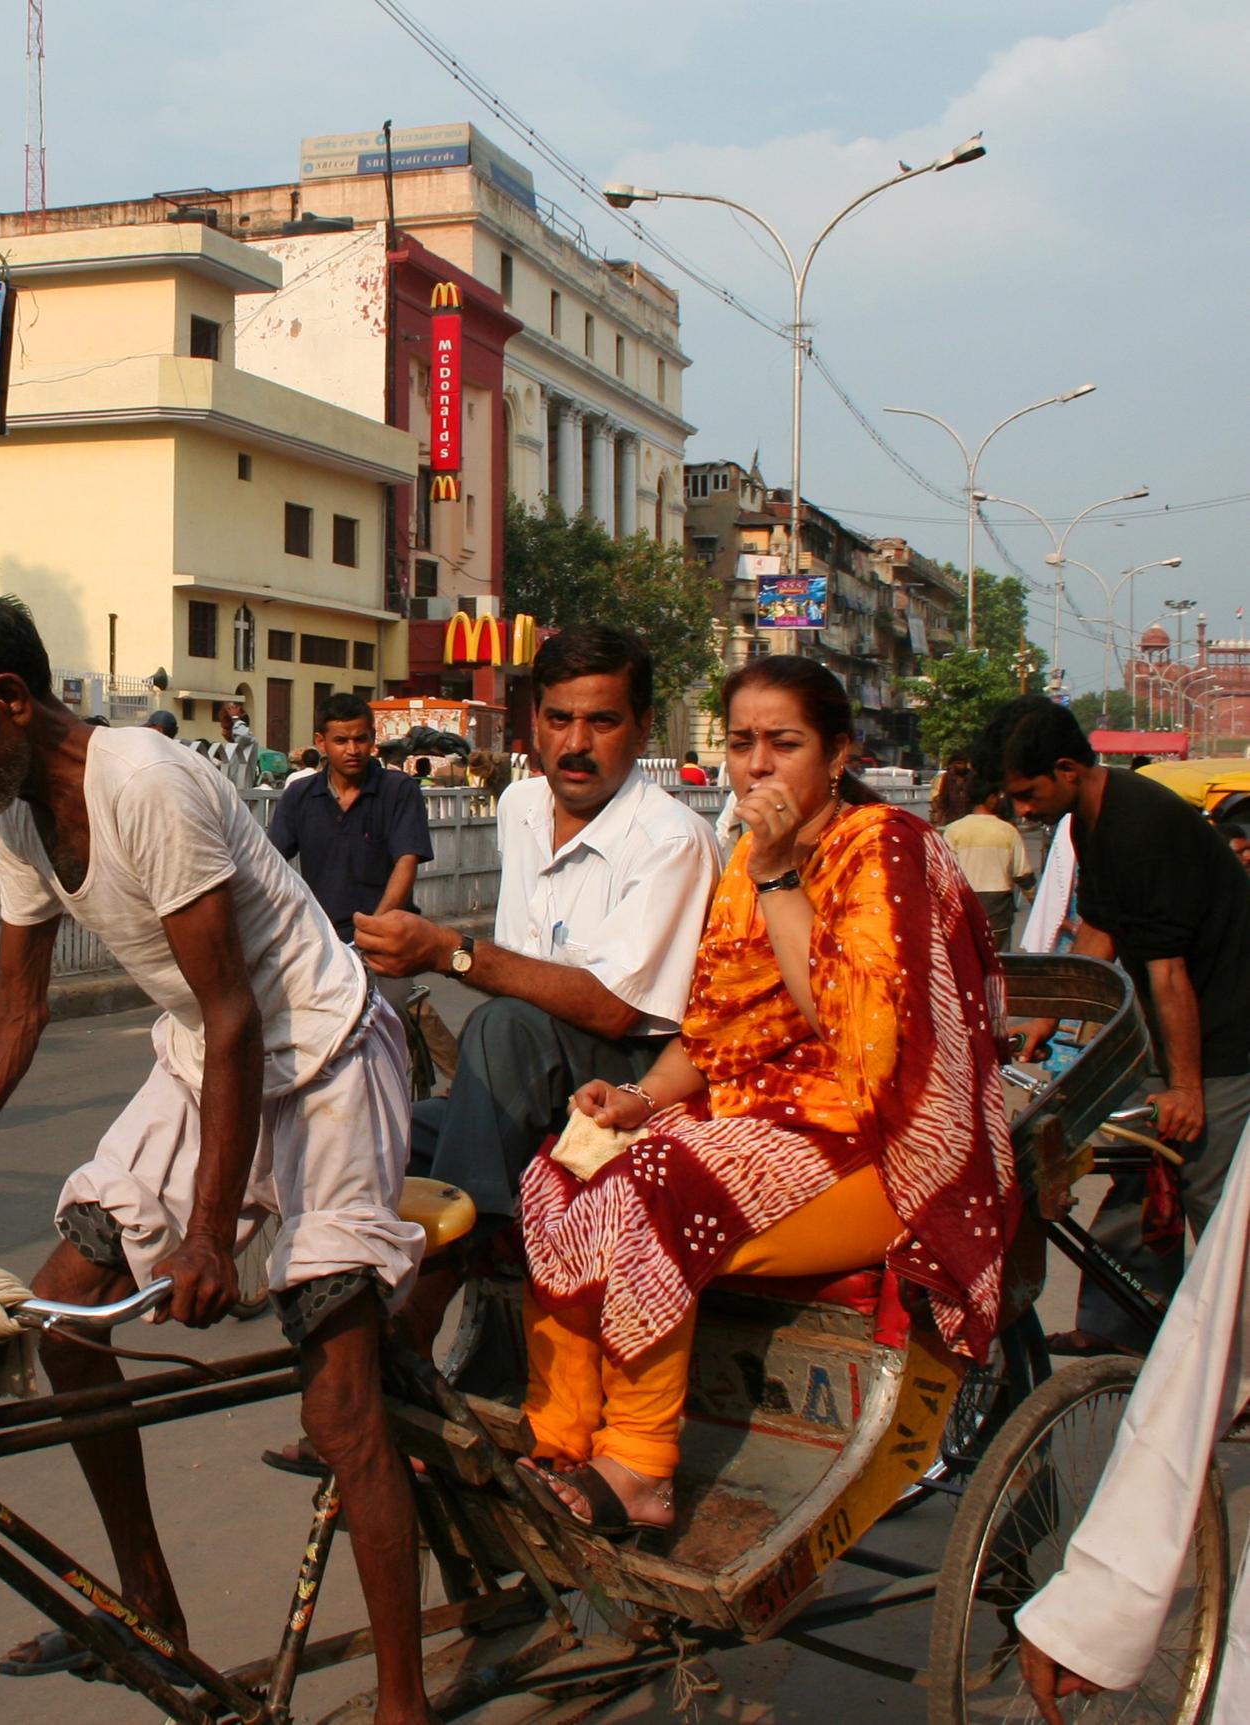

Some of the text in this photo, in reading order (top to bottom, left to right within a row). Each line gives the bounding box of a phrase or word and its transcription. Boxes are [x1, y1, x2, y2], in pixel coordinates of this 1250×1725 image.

[366, 158, 384, 168] SBI
[423, 152, 454, 163] Cards
[438, 340, 452, 460] McDonald's
[1092, 1244, 1142, 1290] NEELAM
